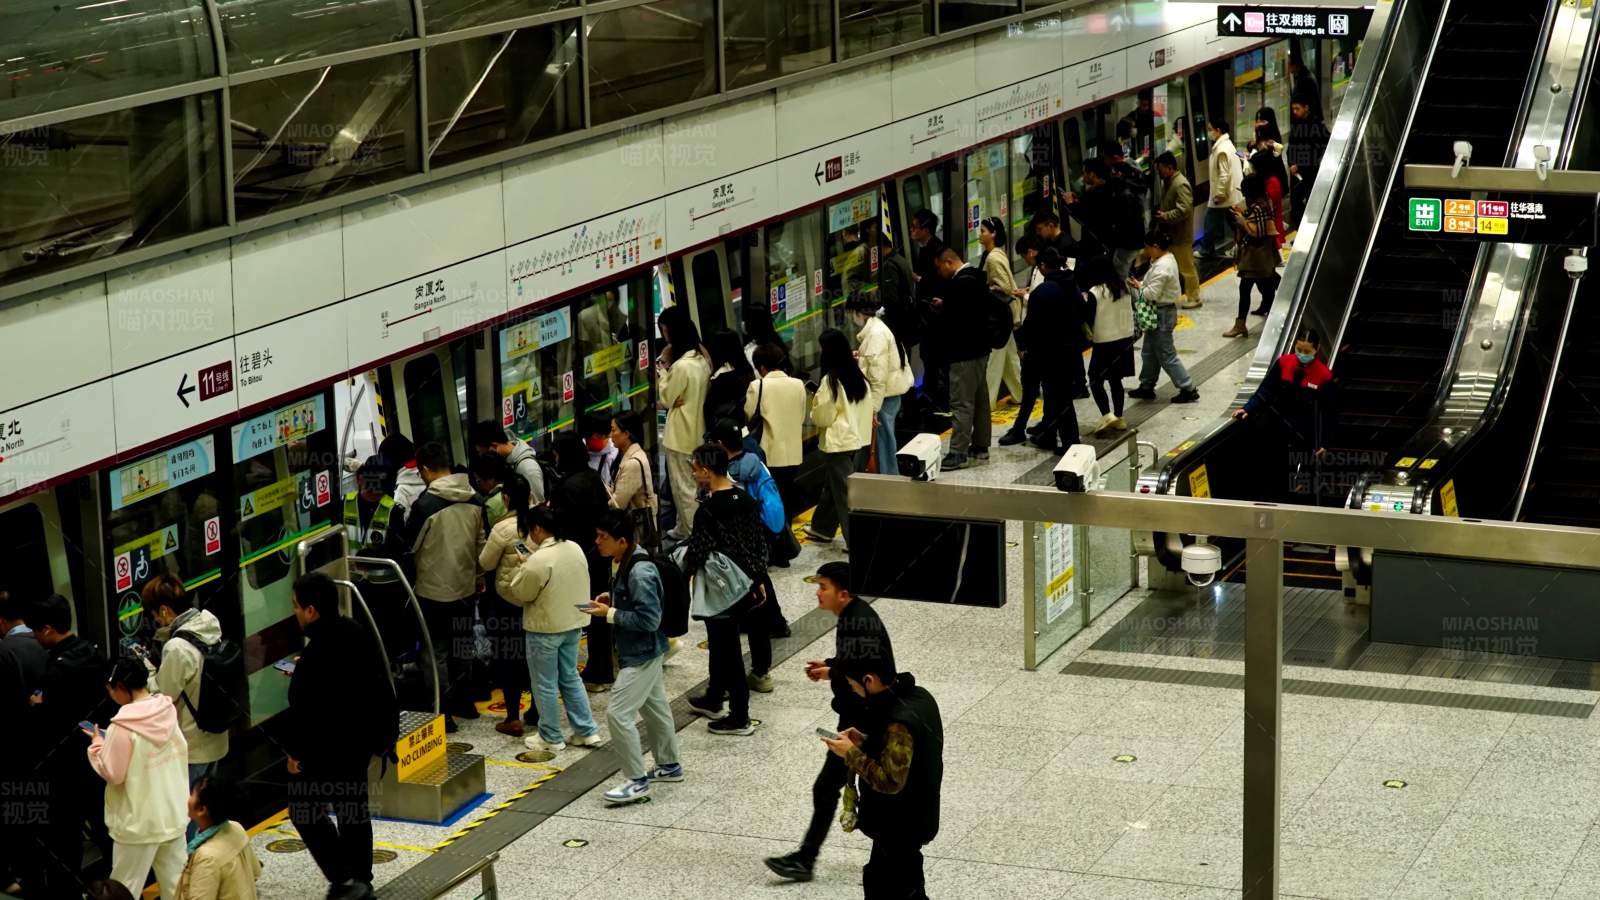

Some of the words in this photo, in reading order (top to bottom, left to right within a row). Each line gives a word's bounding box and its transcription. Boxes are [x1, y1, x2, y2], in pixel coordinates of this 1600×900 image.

[1266, 12, 1316, 27] 往双拥街
[1275, 27, 1316, 35] Shuangyong
[1415, 203, 1435, 219] 出
[1510, 202, 1543, 214] 往华强南
[415, 279, 445, 300] 岗厦北
[414, 297, 433, 311] Gangxia
[433, 294, 447, 304] North
[240, 347, 273, 374] 往碧头
[202, 369, 230, 395] 11号线
[240, 379, 247, 387] To
[248, 374, 263, 385] Bitou
[6, 438, 24, 450] North
[401, 753, 411, 769] NO
[412, 734, 443, 761] CLIMBING
